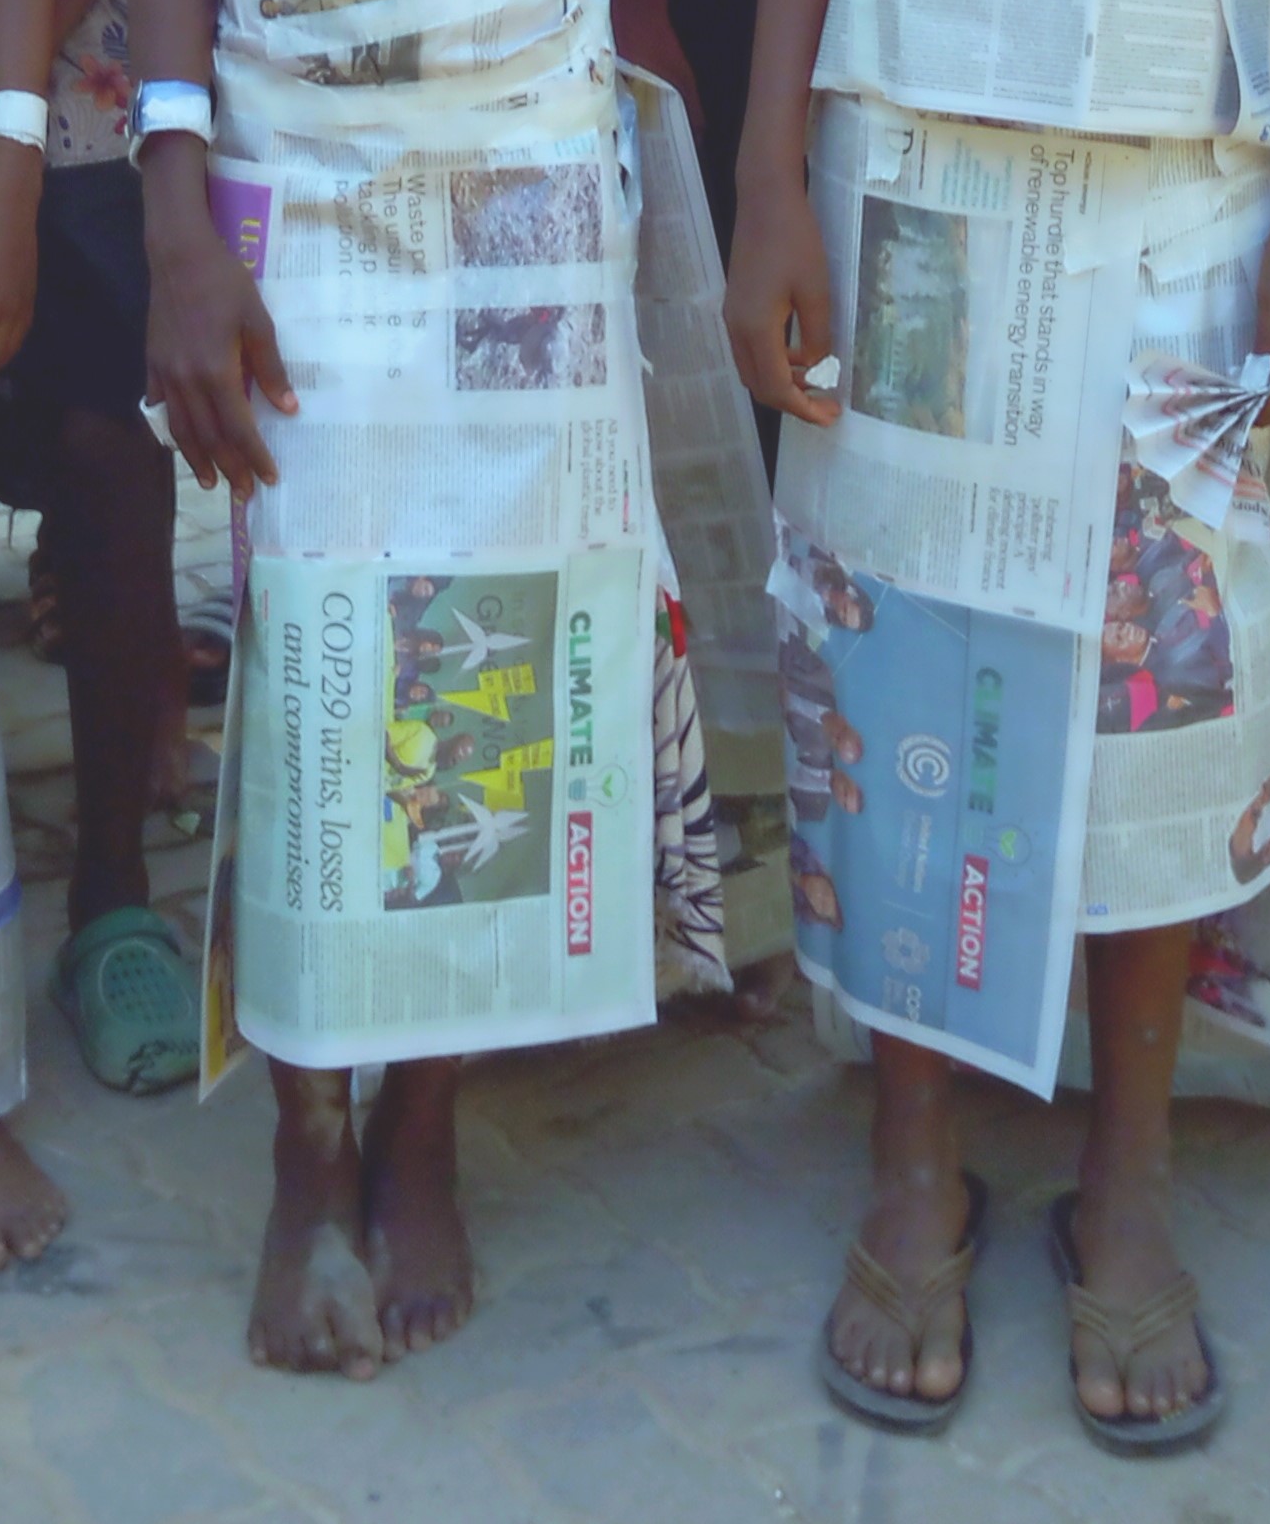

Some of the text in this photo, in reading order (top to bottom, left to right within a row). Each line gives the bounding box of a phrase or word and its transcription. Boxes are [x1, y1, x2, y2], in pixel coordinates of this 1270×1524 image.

[332, 179, 356, 264] pollution
[356, 179, 382, 255] tackling
[383, 175, 404, 217] The
[406, 172, 428, 244] Waste
[1004, 144, 1050, 447] of renewable energy transition
[1024, 148, 1076, 439] Top hurdle that stands in way
[281, 622, 310, 912] and compromises
[315, 591, 355, 914] COP29 wins, losses
[568, 610, 594, 946] CLIMATE ACTION
[958, 666, 1004, 981] CLIMATE ACTION
